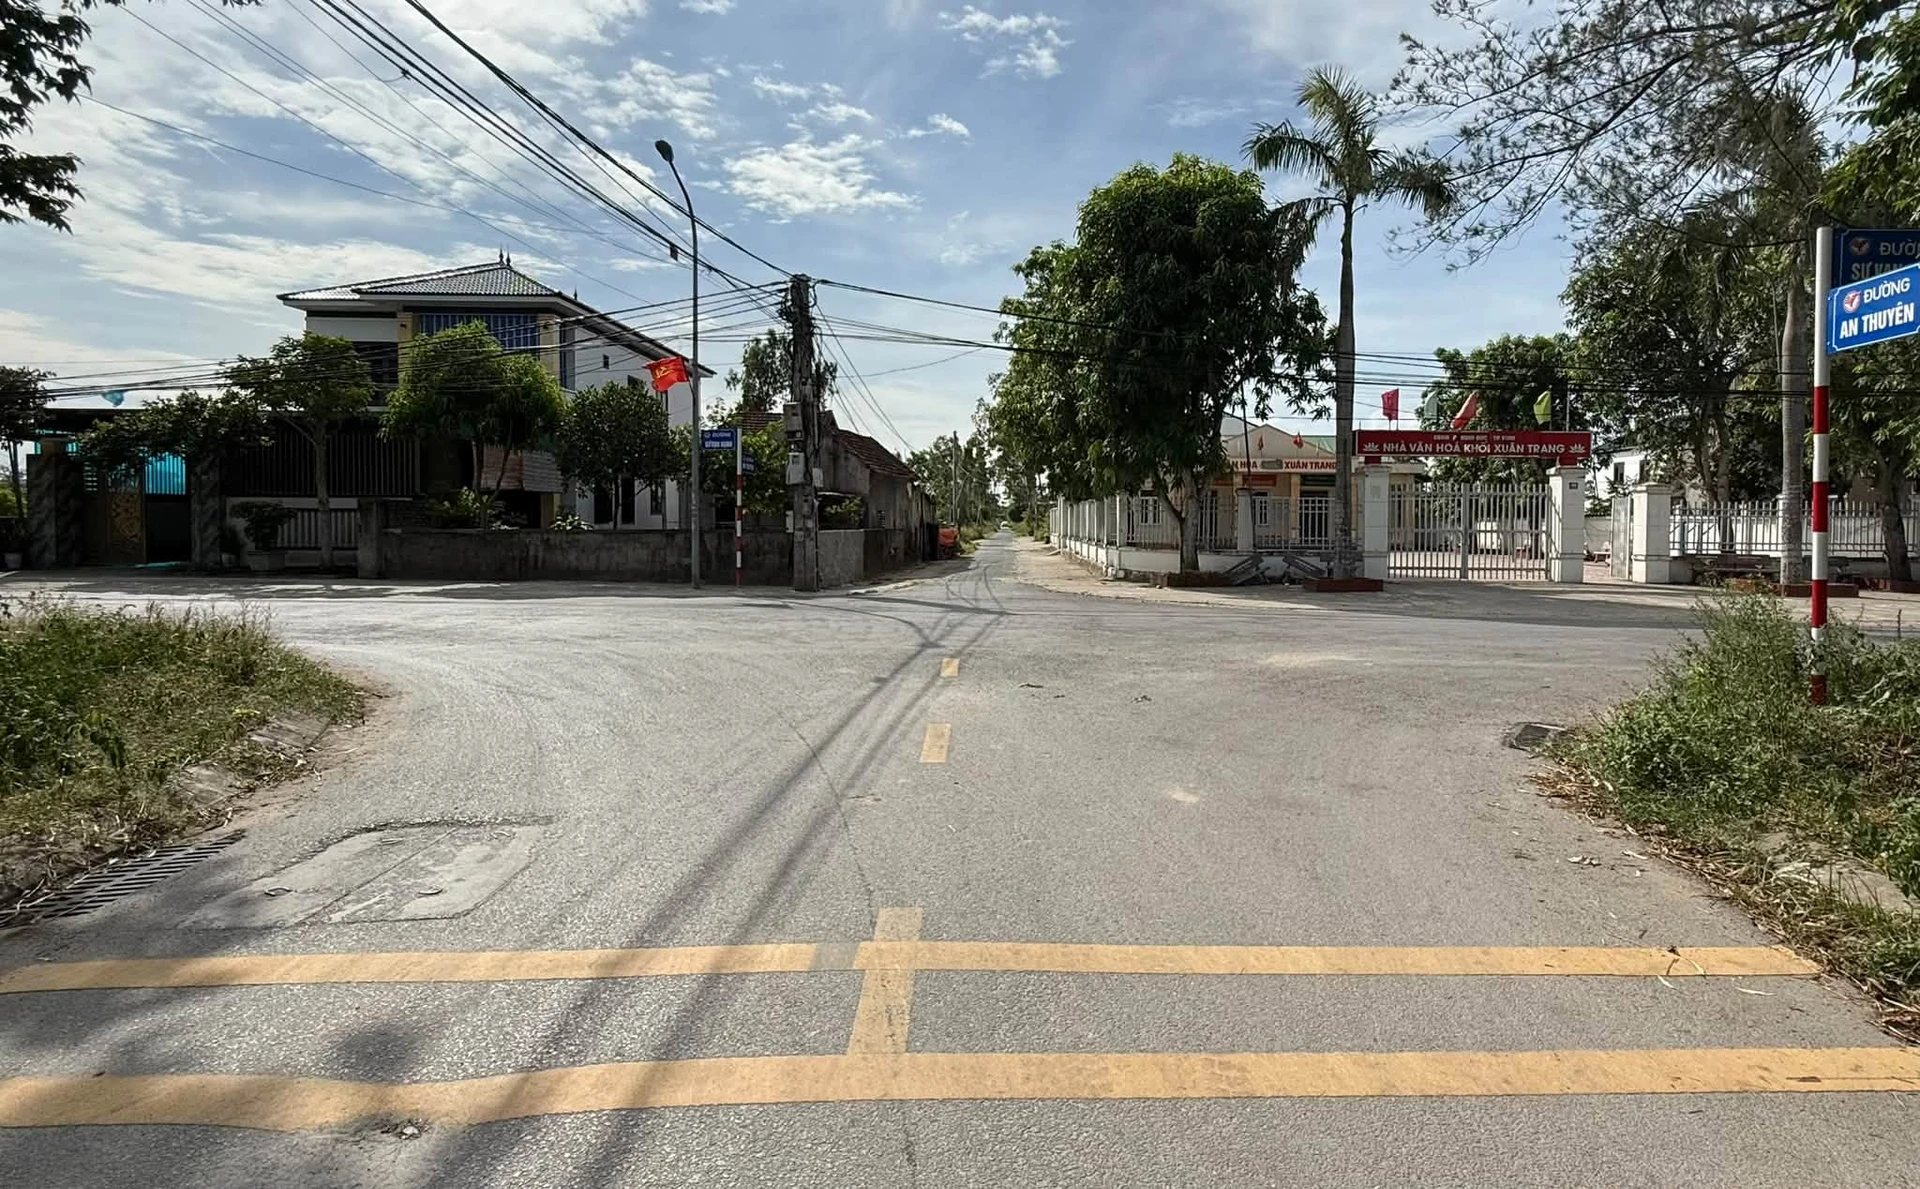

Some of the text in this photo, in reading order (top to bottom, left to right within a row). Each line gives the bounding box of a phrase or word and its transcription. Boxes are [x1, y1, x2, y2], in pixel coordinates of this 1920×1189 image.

[1879, 239, 1920, 256] ĐƯỜ
[1863, 277, 1910, 303] ĐƯỜNG
[1839, 301, 1914, 339] AN THUYÊN
[1383, 441, 1407, 452] NHÀ
[1409, 441, 1432, 452] VĂN
[1436, 441, 1461, 453] HOÁ
[1494, 442, 1524, 453] XUÂN
[1527, 443, 1565, 454] TRANG
